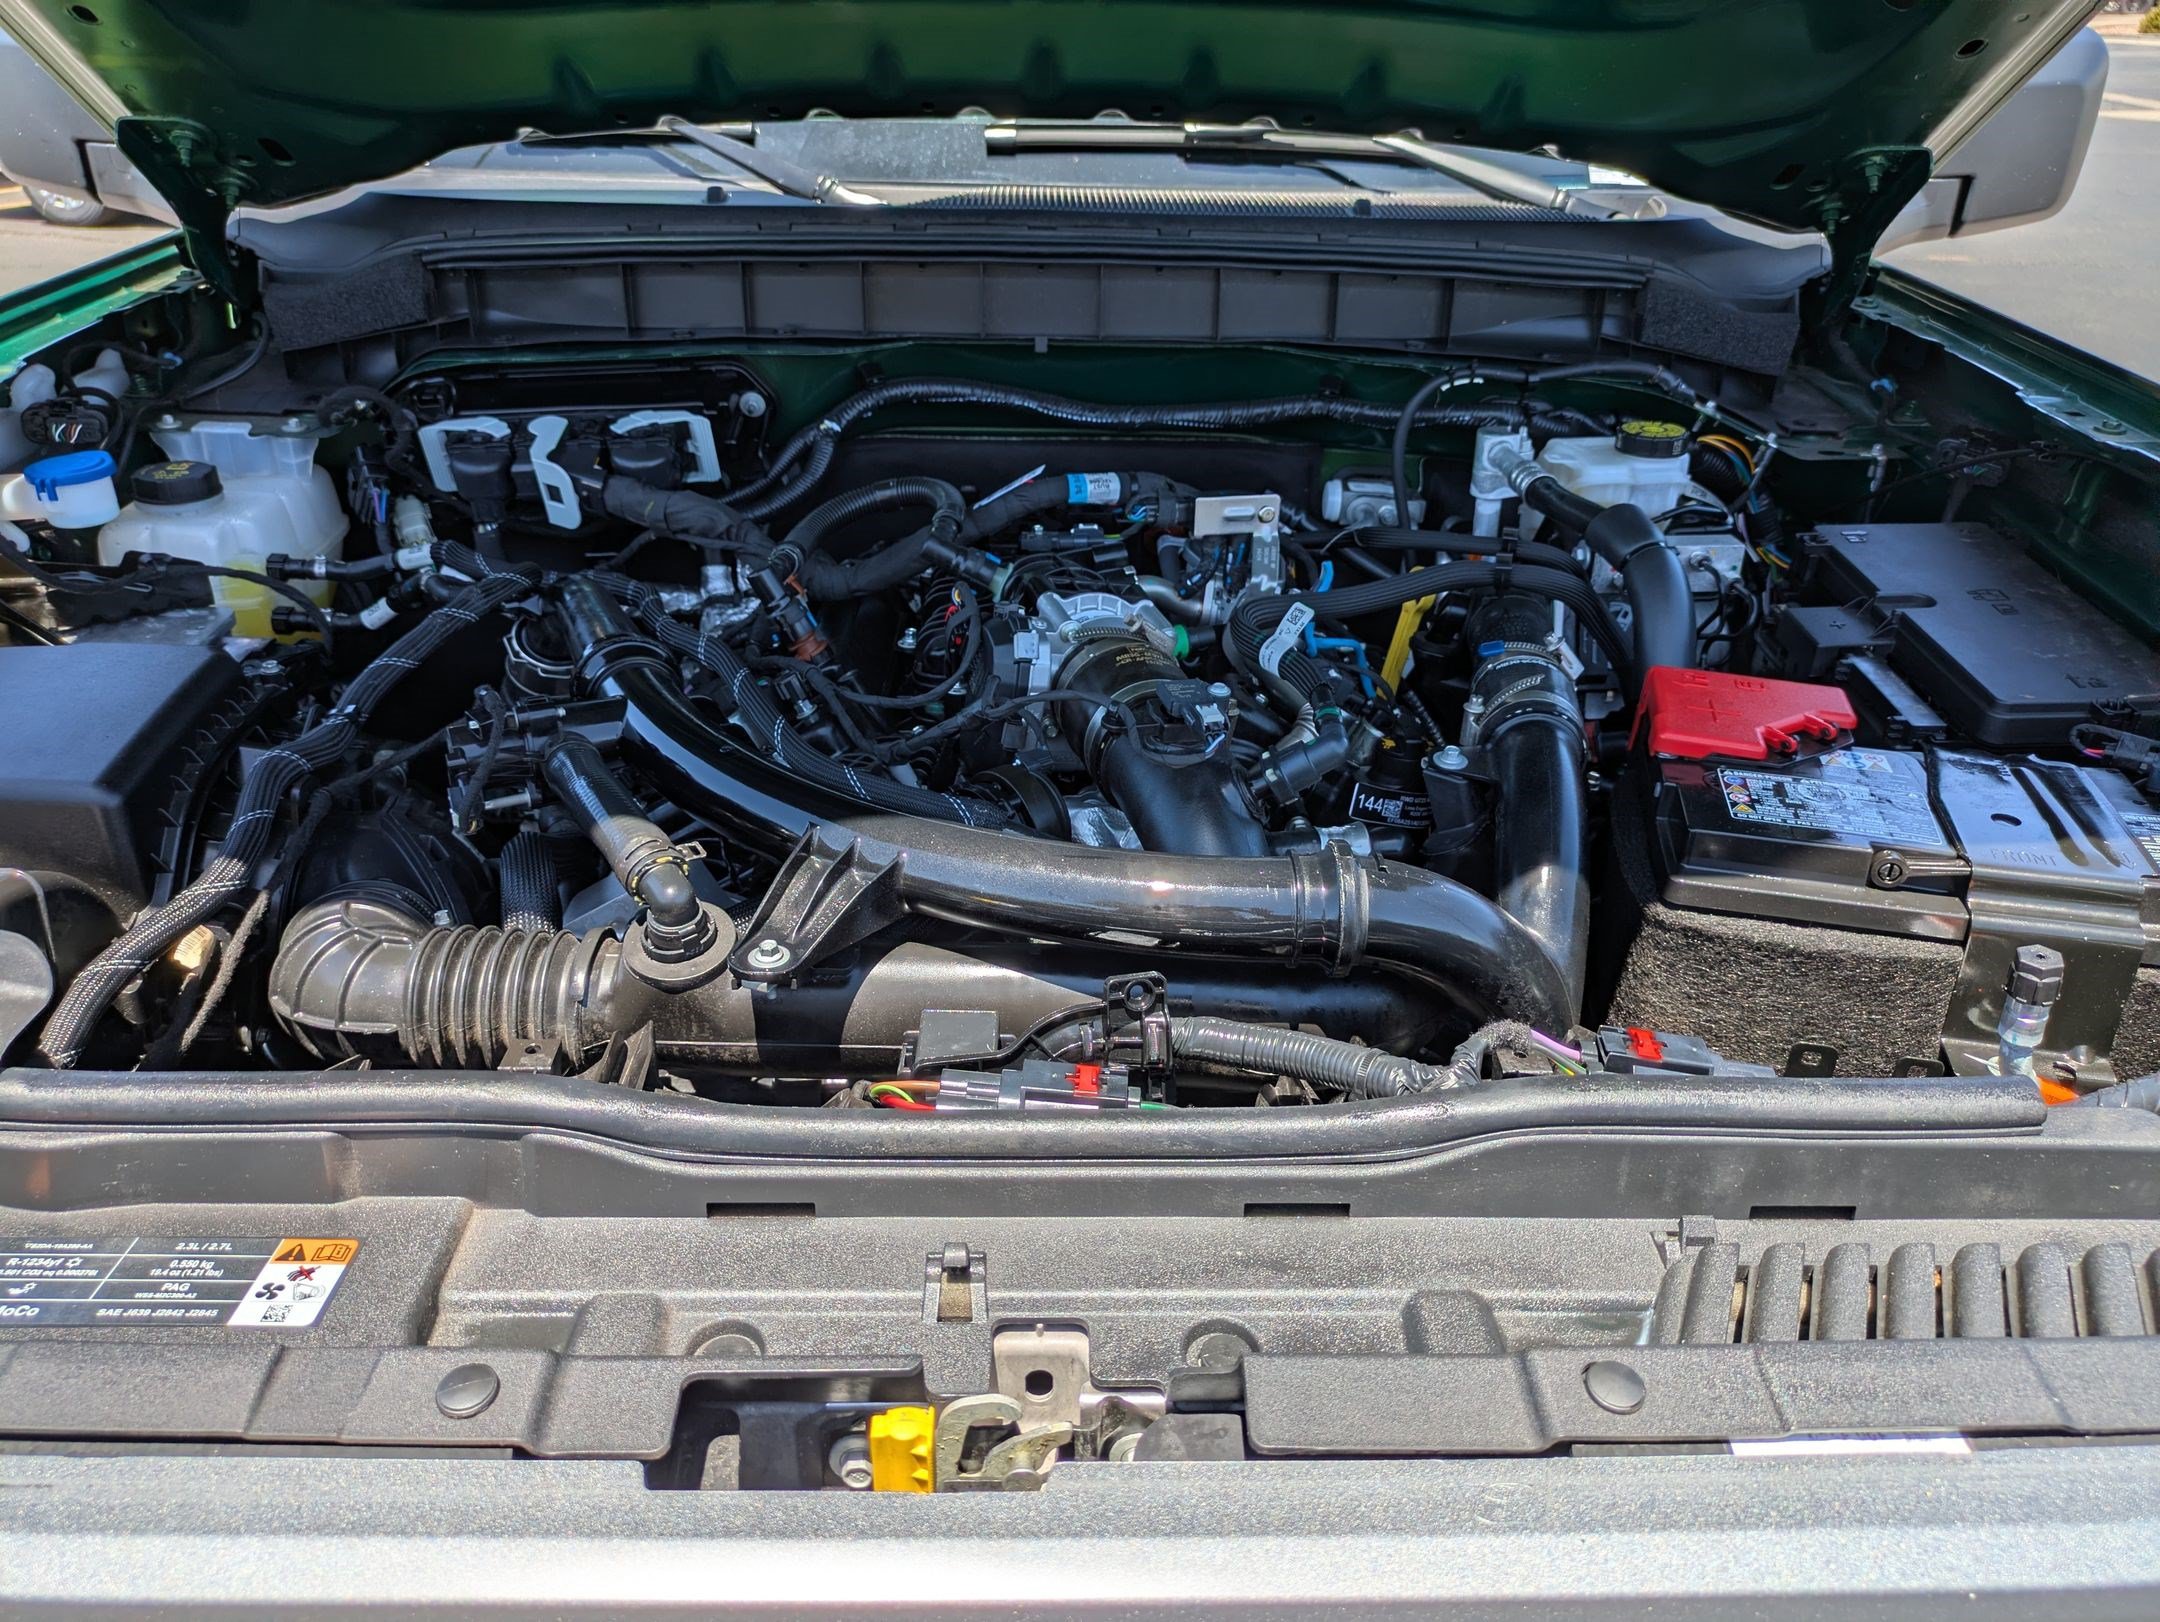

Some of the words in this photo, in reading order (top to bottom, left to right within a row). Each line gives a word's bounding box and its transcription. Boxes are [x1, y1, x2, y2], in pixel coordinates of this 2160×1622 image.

[1358, 793, 1384, 813] 144
[1990, 847, 2057, 866] FRONT
[6, 1258, 65, 1267] R-1234yf
[201, 1260, 215, 1269] kg
[181, 1269, 204, 1277] (1.21
[205, 1269, 224, 1277] lbs)
[161, 1283, 190, 1291] PAG
